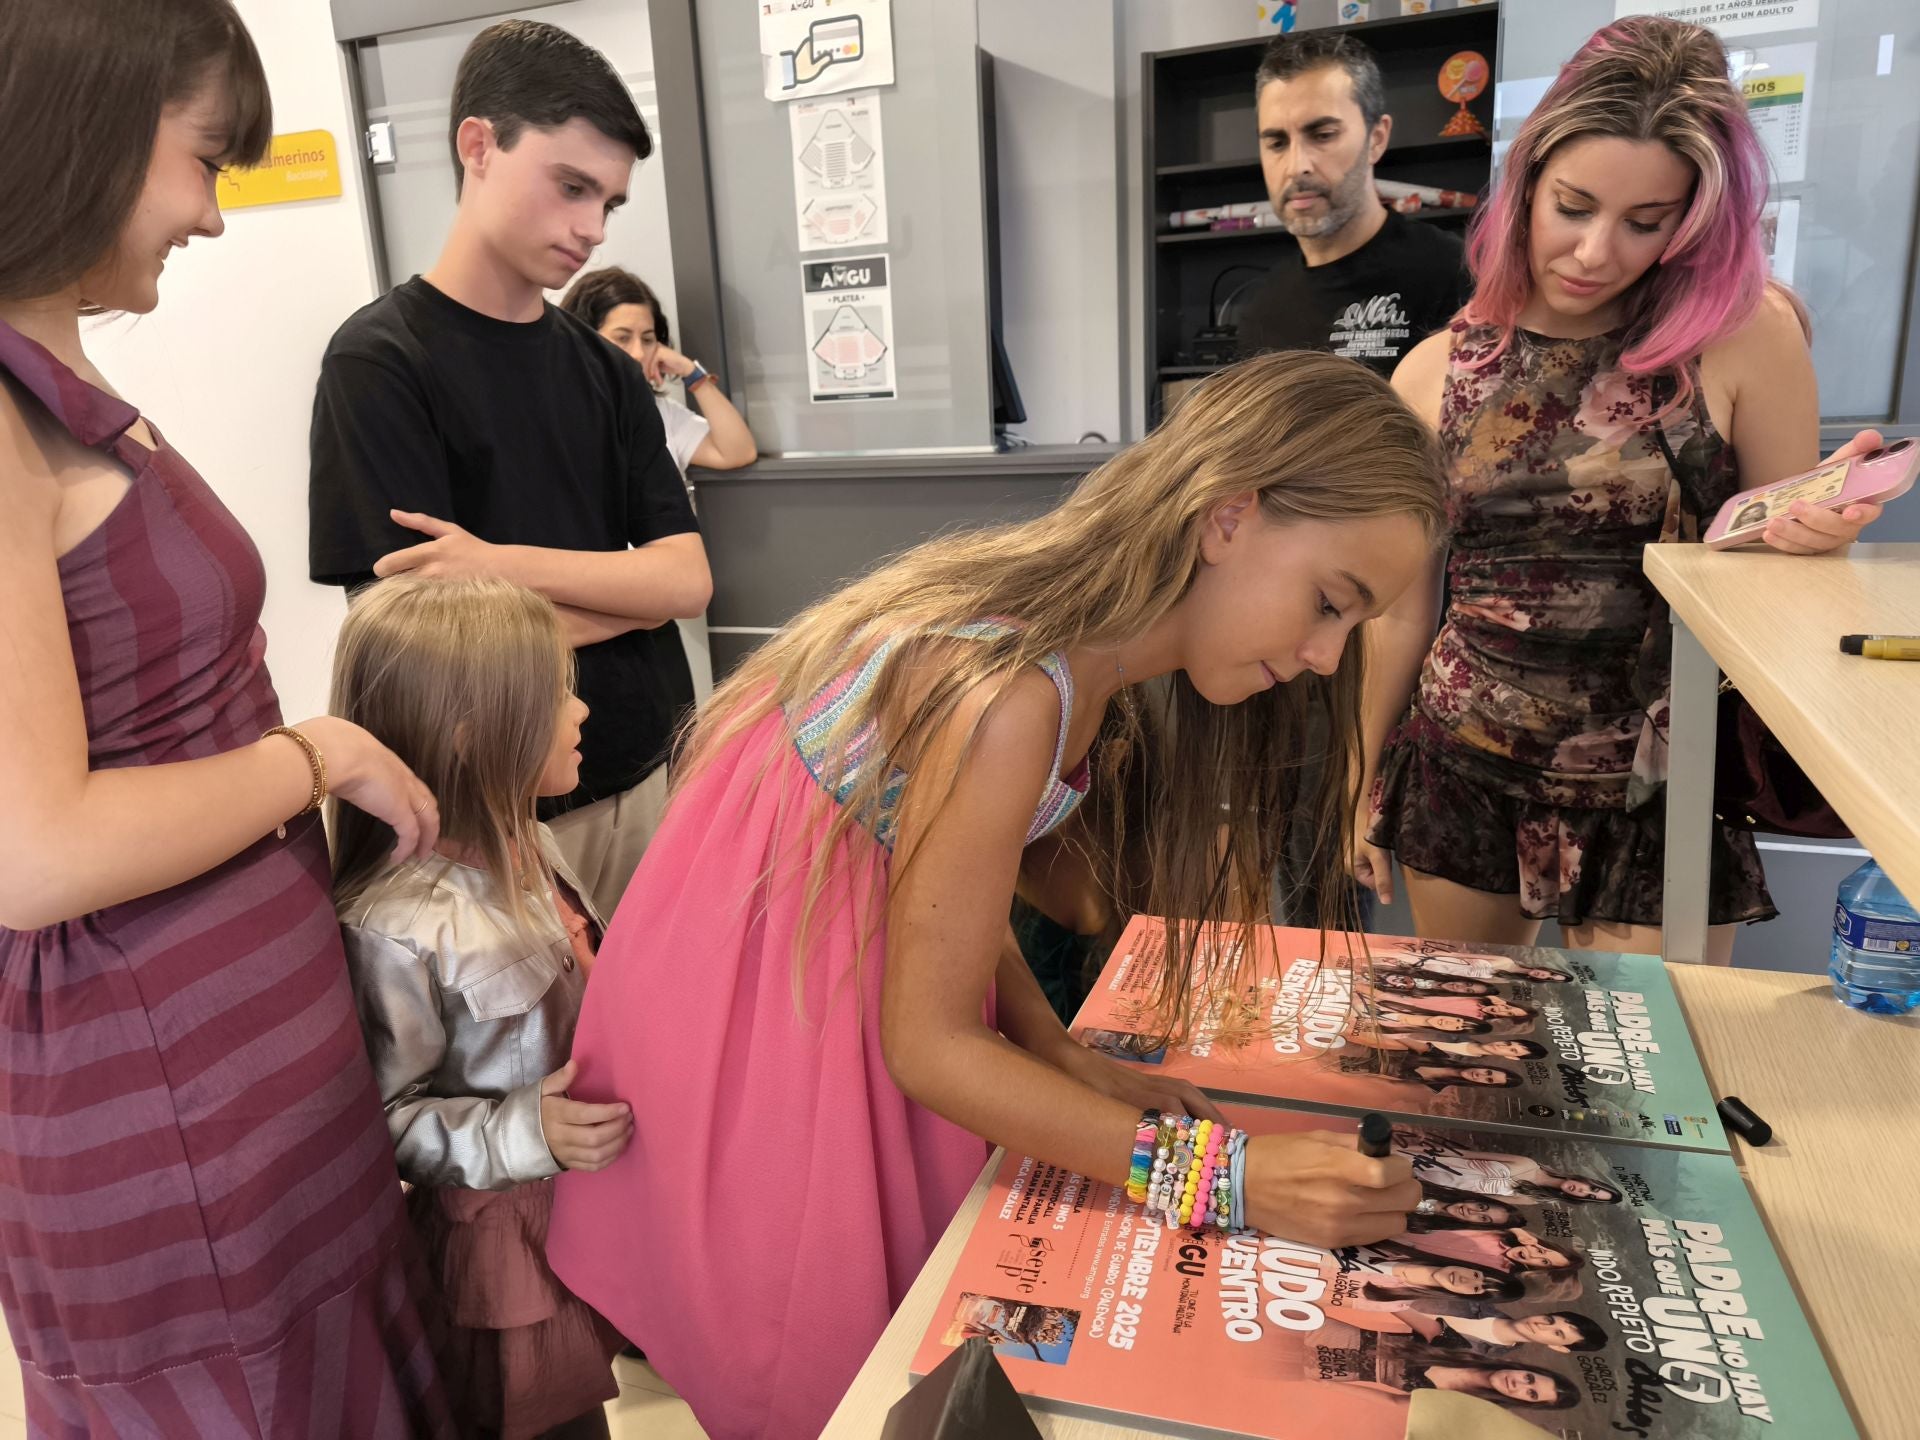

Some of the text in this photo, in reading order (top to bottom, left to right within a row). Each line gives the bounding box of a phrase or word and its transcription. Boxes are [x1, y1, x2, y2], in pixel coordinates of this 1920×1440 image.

[1700, 6, 1712, 14] DE
[1720, 13, 1738, 21] POR
[1757, 6, 1793, 16] ADULTO
[820, 267, 872, 289] AMGU
[833, 295, 860, 304] PLATEA
[1270, 958, 1320, 1054] REENCUENTRO
[1301, 968, 1354, 1049] MENUDO
[1588, 1012, 1609, 1032] QUE
[1608, 990, 1660, 1054] PADRE
[1547, 1025, 1582, 1061] REPLETO
[1624, 1052, 1646, 1069] NO
[1628, 1069, 1656, 1094] HAY
[1028, 1169, 1042, 1187] GRAN
[1042, 1179, 1052, 1189] DE
[1630, 1173, 1654, 1201] MARTINA
[1038, 1188, 1048, 1198] LA
[1043, 1179, 1063, 1218] PHOTOCALL
[1064, 1185, 1077, 1203] QUE
[1027, 1197, 1044, 1225] FAMILIA
[1055, 1204, 1071, 1222] UNO
[1052, 1223, 1064, 1231] 5
[1098, 1220, 1113, 1247] Entradas
[1639, 1218, 1679, 1258] MÁS
[1114, 1241, 1126, 1252] DE
[996, 1263, 1022, 1278] p
[1016, 1249, 1047, 1294] serie
[1080, 1247, 1102, 1299] www.amgu.org
[1104, 1253, 1124, 1286] GUARDO
[1653, 1259, 1685, 1296] QUE
[1218, 1234, 1264, 1343] UENTRO
[1347, 1280, 1361, 1299] LUNA
[1107, 1301, 1142, 1350] 2025
[1599, 1282, 1656, 1353] REPLETO
[1672, 1219, 1774, 1424] PADRE NO HAY
[1316, 1344, 1333, 1380] SEGURA
[1593, 1356, 1618, 1392] CARLOS
